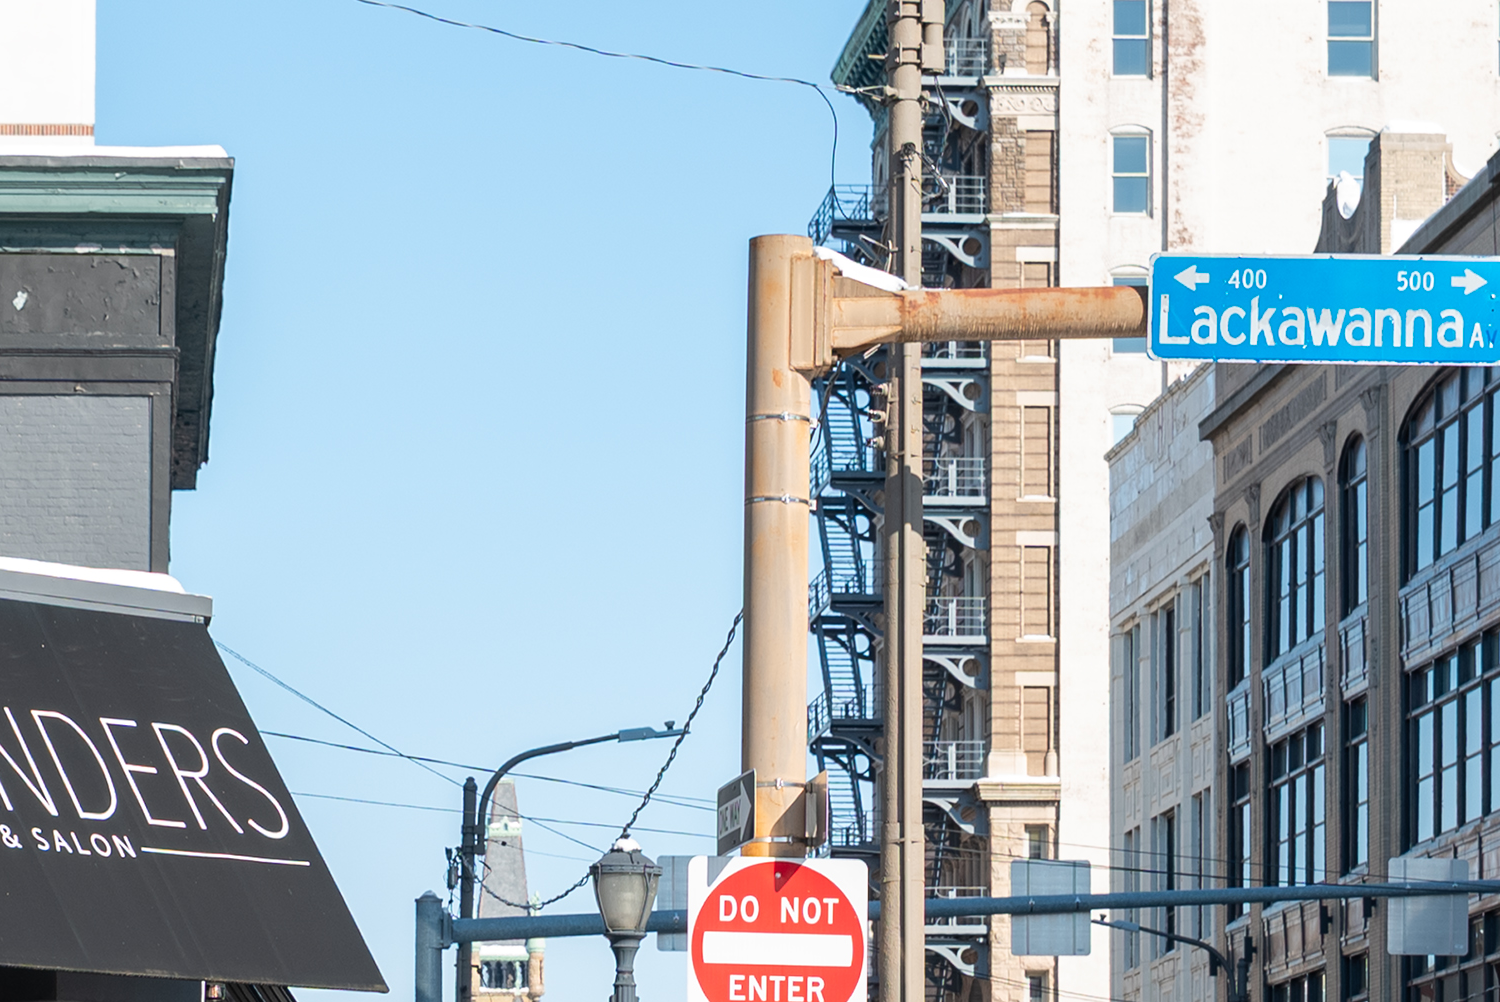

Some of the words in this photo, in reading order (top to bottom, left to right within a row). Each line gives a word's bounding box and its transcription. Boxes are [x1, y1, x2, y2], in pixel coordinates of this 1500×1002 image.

[1228, 269, 1267, 289] 400
[1397, 271, 1435, 292] 500
[1158, 293, 1464, 348] Lackawanna
[729, 797, 742, 830] WAY
[33, 828, 138, 859] SALON
[718, 894, 760, 924] DO
[780, 895, 840, 925] NOT
